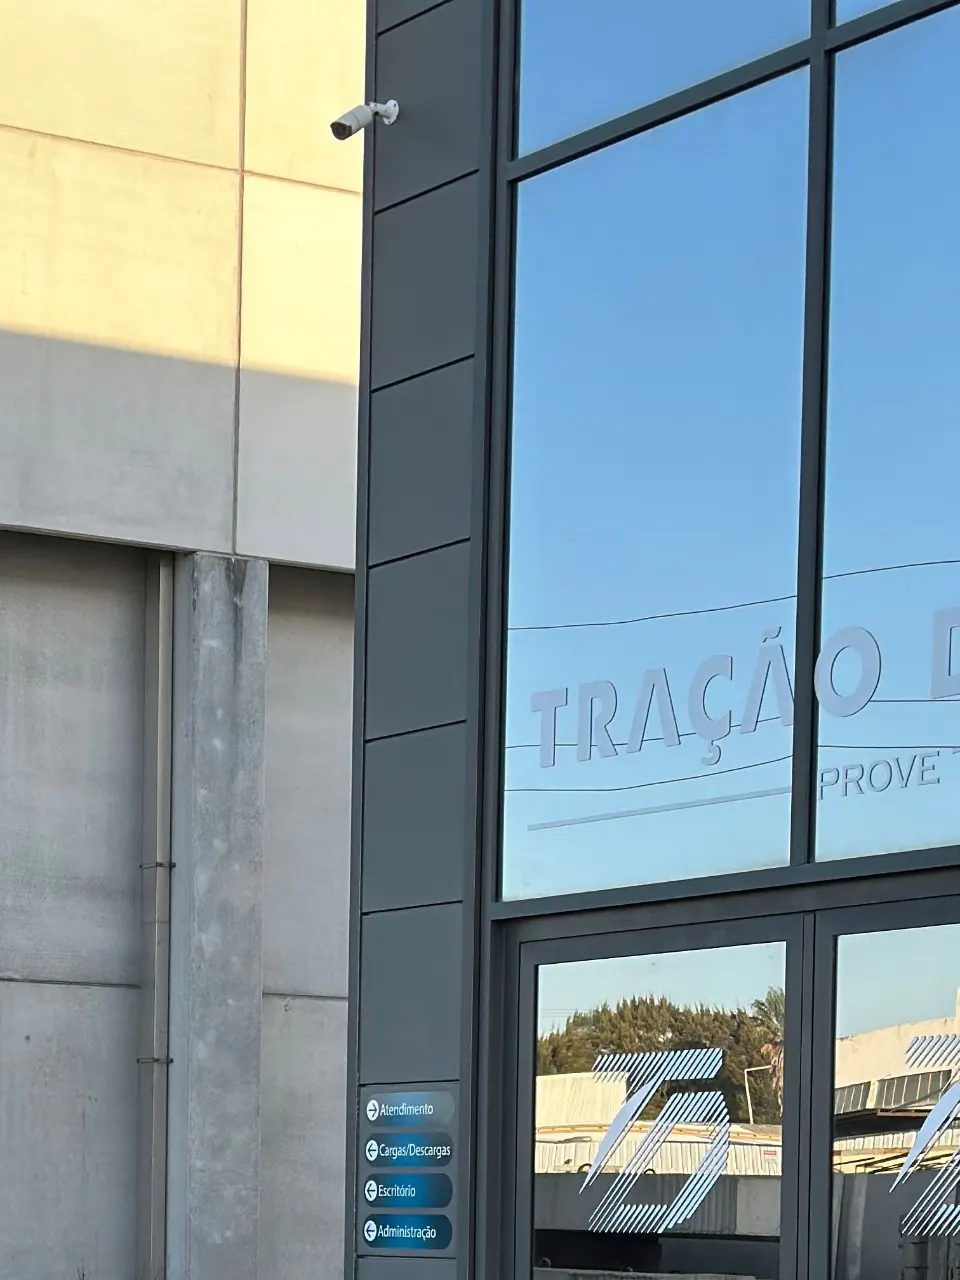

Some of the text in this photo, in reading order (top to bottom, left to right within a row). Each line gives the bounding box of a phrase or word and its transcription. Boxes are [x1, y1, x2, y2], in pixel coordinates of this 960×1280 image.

[530, 626, 882, 768] TRAÇÃO
[819, 750, 940, 800] PROVE
[380, 1103, 434, 1116] Atendimento
[378, 1143, 451, 1160] Cargas/Descargas
[378, 1184, 416, 1197] Escritório
[377, 1224, 437, 1241] Administração
